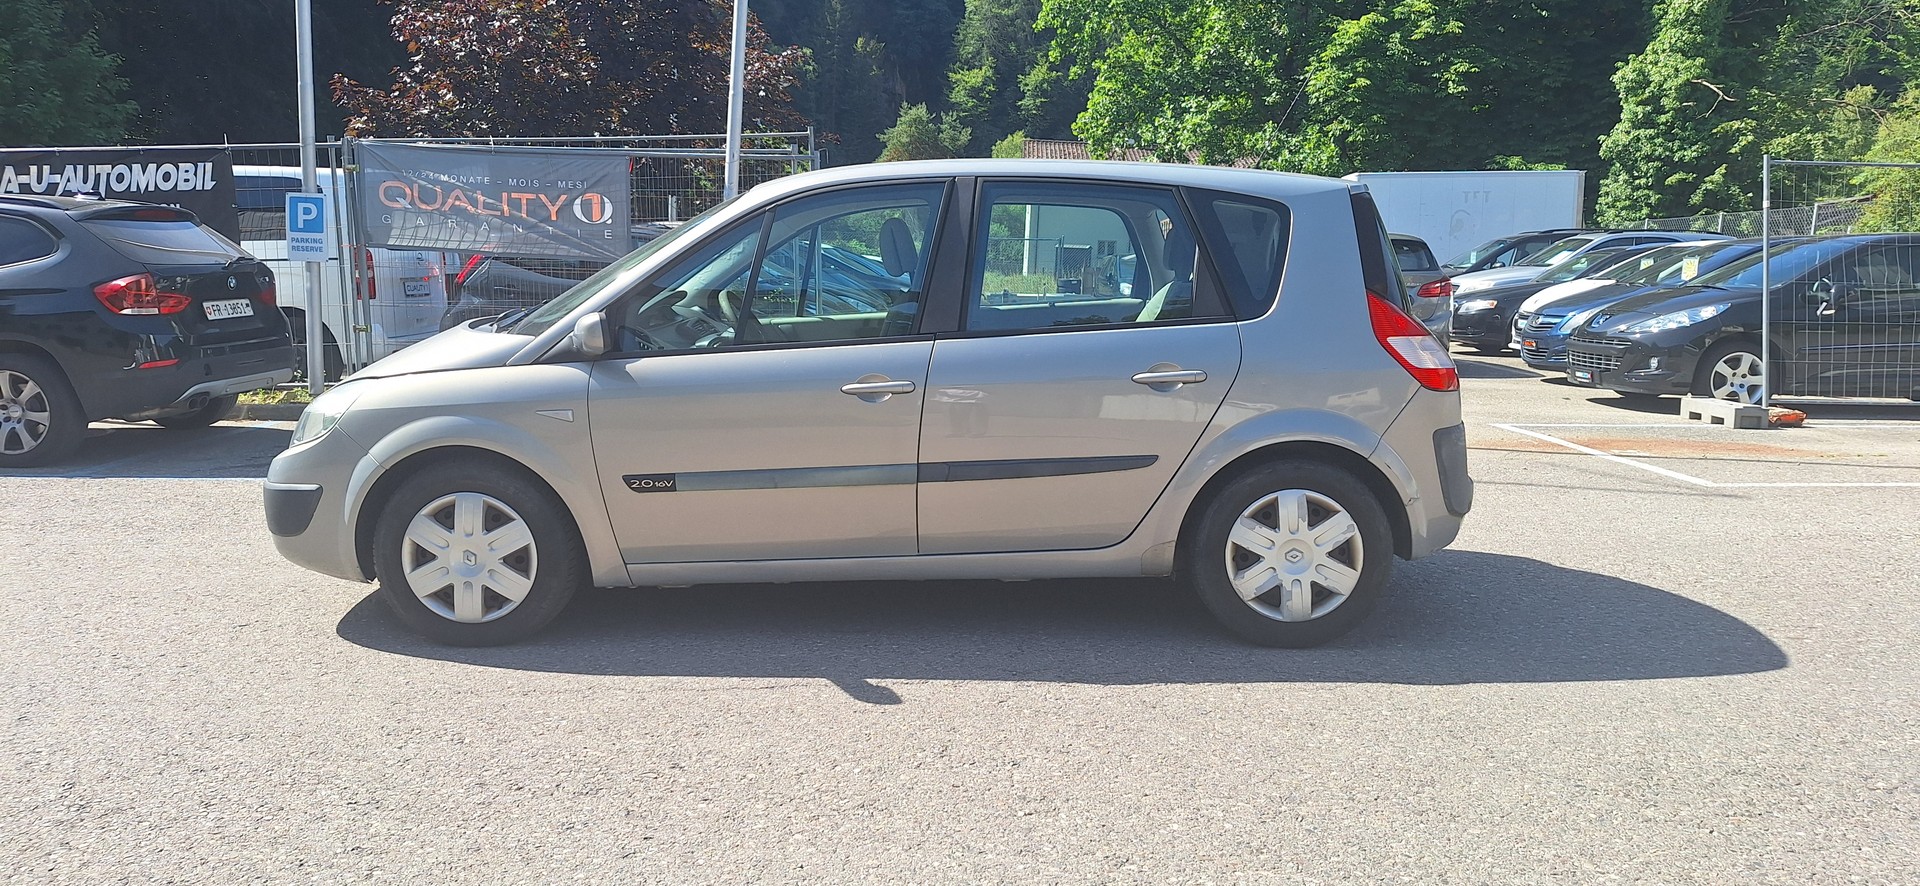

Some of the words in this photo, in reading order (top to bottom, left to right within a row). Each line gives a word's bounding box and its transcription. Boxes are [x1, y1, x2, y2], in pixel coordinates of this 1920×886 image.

[440, 173, 491, 185] MONATE
[508, 178, 540, 188] MOIS
[557, 180, 588, 189] MESI
[379, 180, 568, 221] QUALITY
[297, 202, 318, 229] P
[382, 214, 613, 239] GARANTIE
[291, 237, 323, 245] PARKING
[291, 245, 324, 253] RESERVE
[630, 479, 653, 488] 2.0
